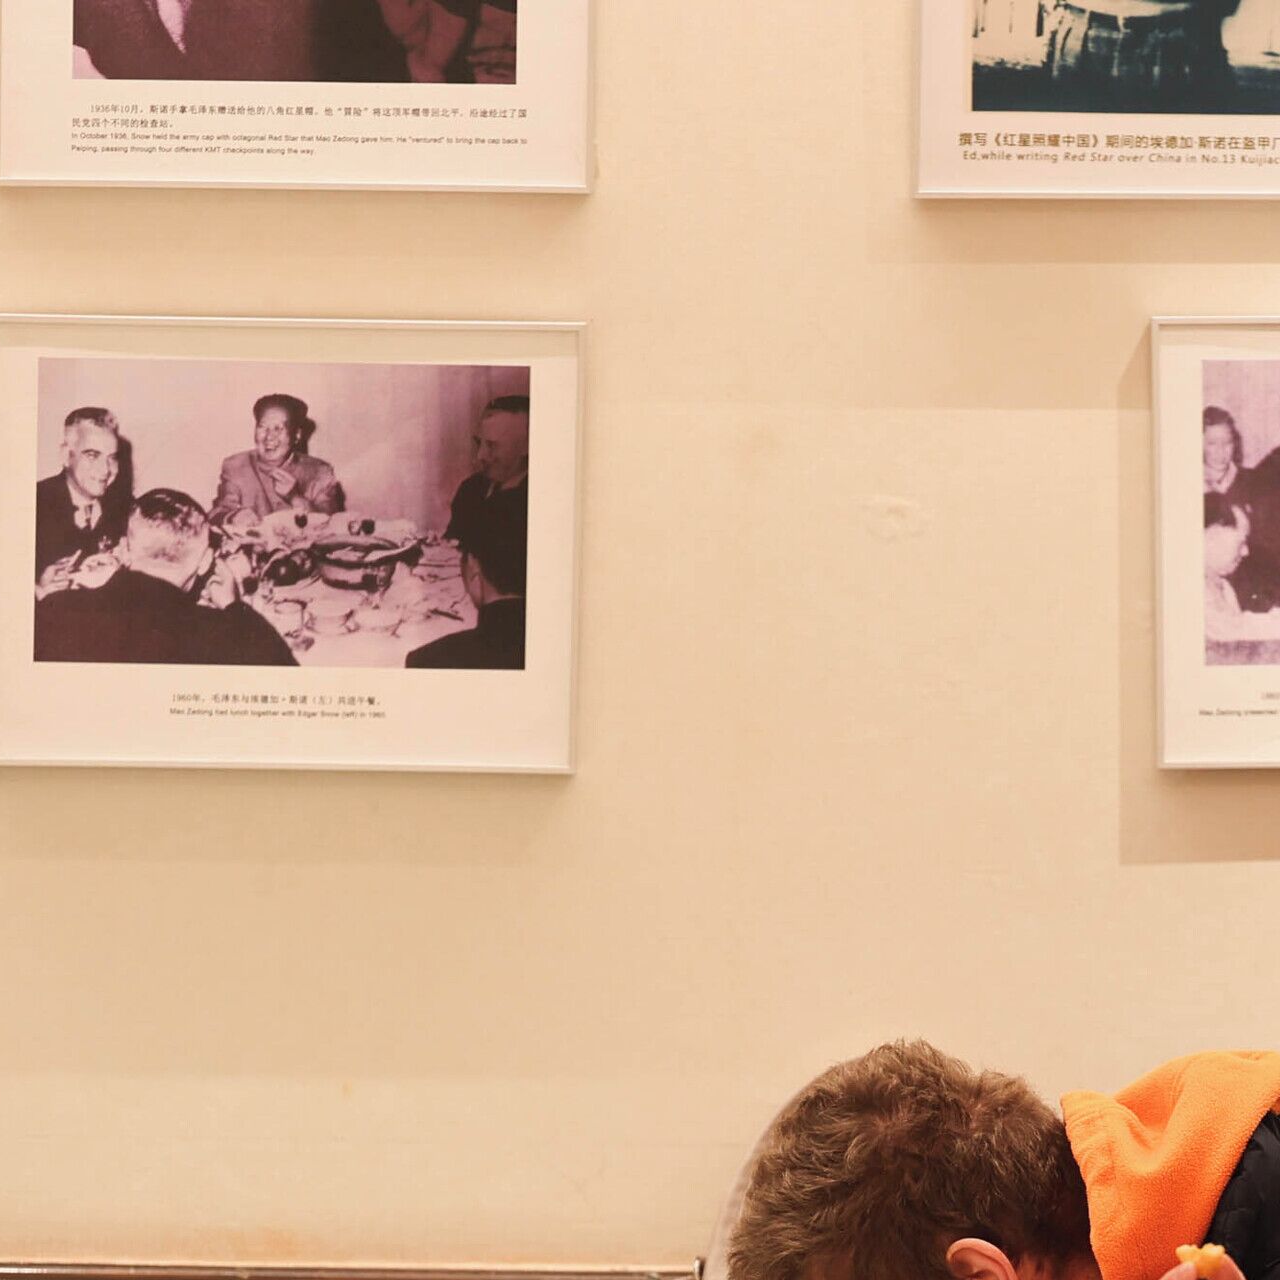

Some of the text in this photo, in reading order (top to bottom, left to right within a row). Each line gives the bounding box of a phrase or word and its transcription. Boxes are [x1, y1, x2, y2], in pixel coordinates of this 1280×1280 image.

[333, 135, 359, 144] Zedong
[1016, 153, 1059, 163] writing
[1064, 152, 1086, 161] Red
[1089, 152, 1114, 162] Star
[1148, 153, 1182, 163] China
[1185, 154, 1198, 163] in
